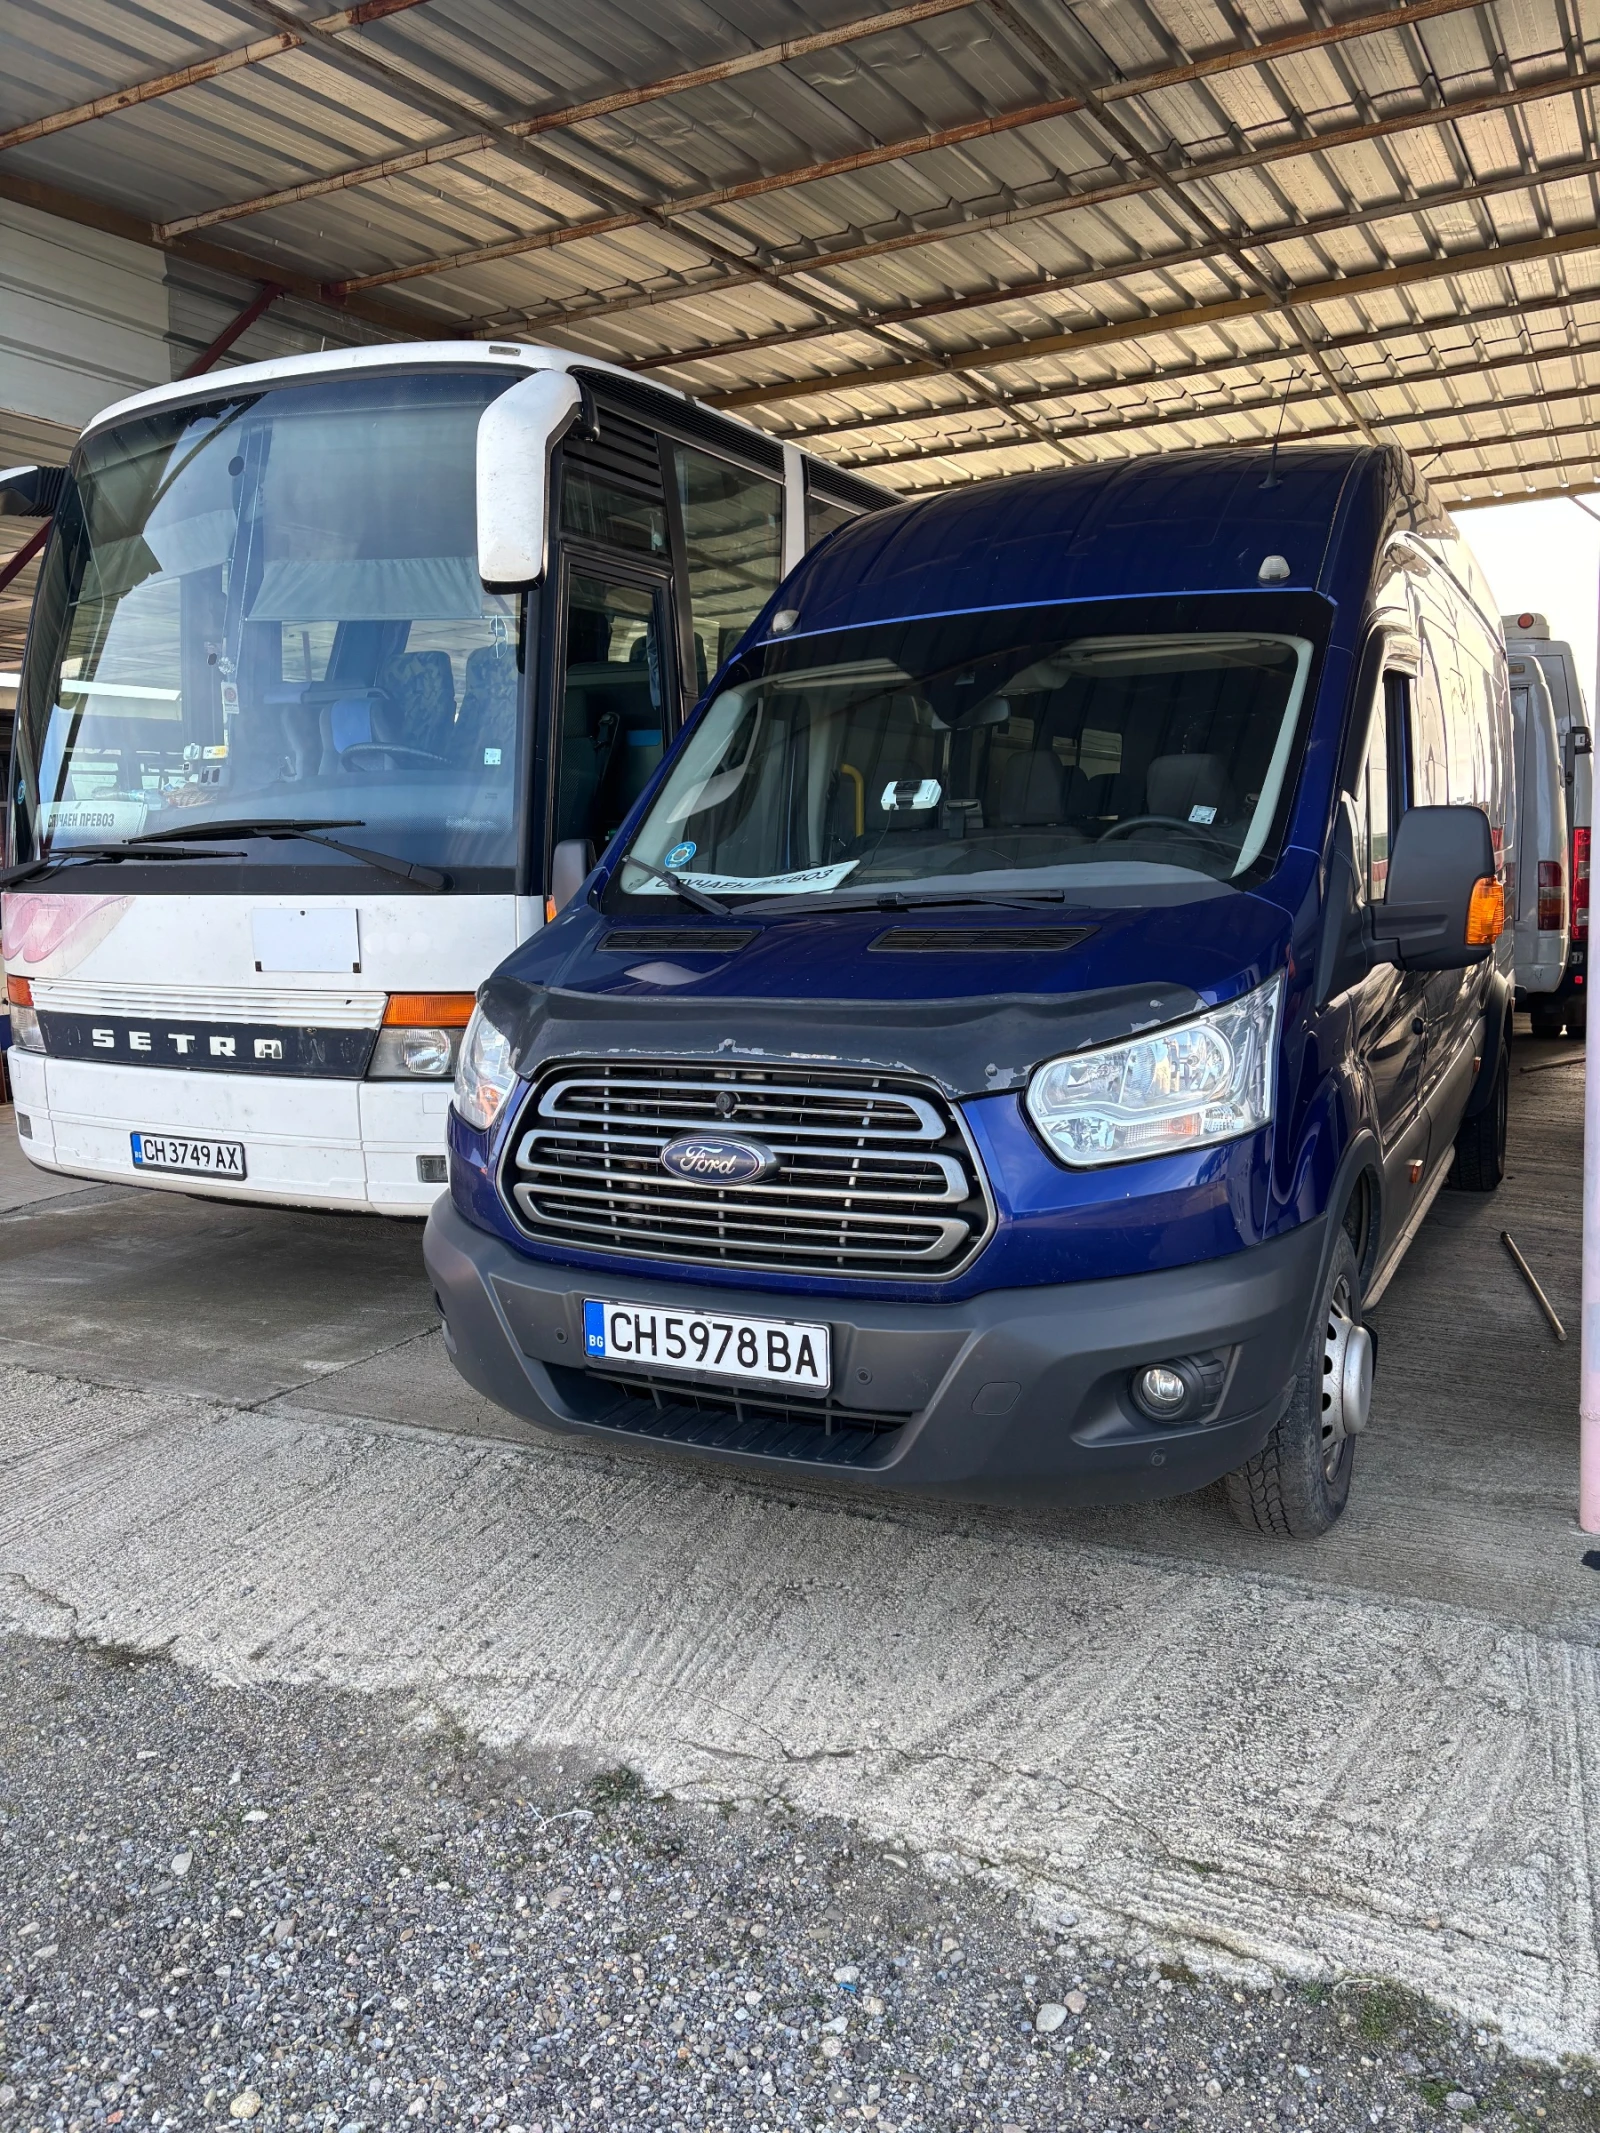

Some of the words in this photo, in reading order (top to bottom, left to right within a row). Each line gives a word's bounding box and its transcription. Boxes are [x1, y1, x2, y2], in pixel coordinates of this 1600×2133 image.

[79, 812, 115, 827] ПРЕВОЗ
[92, 1028, 283, 1060] SETRA
[680, 1146, 737, 1175] Ford
[589, 1334, 604, 1348] BG
